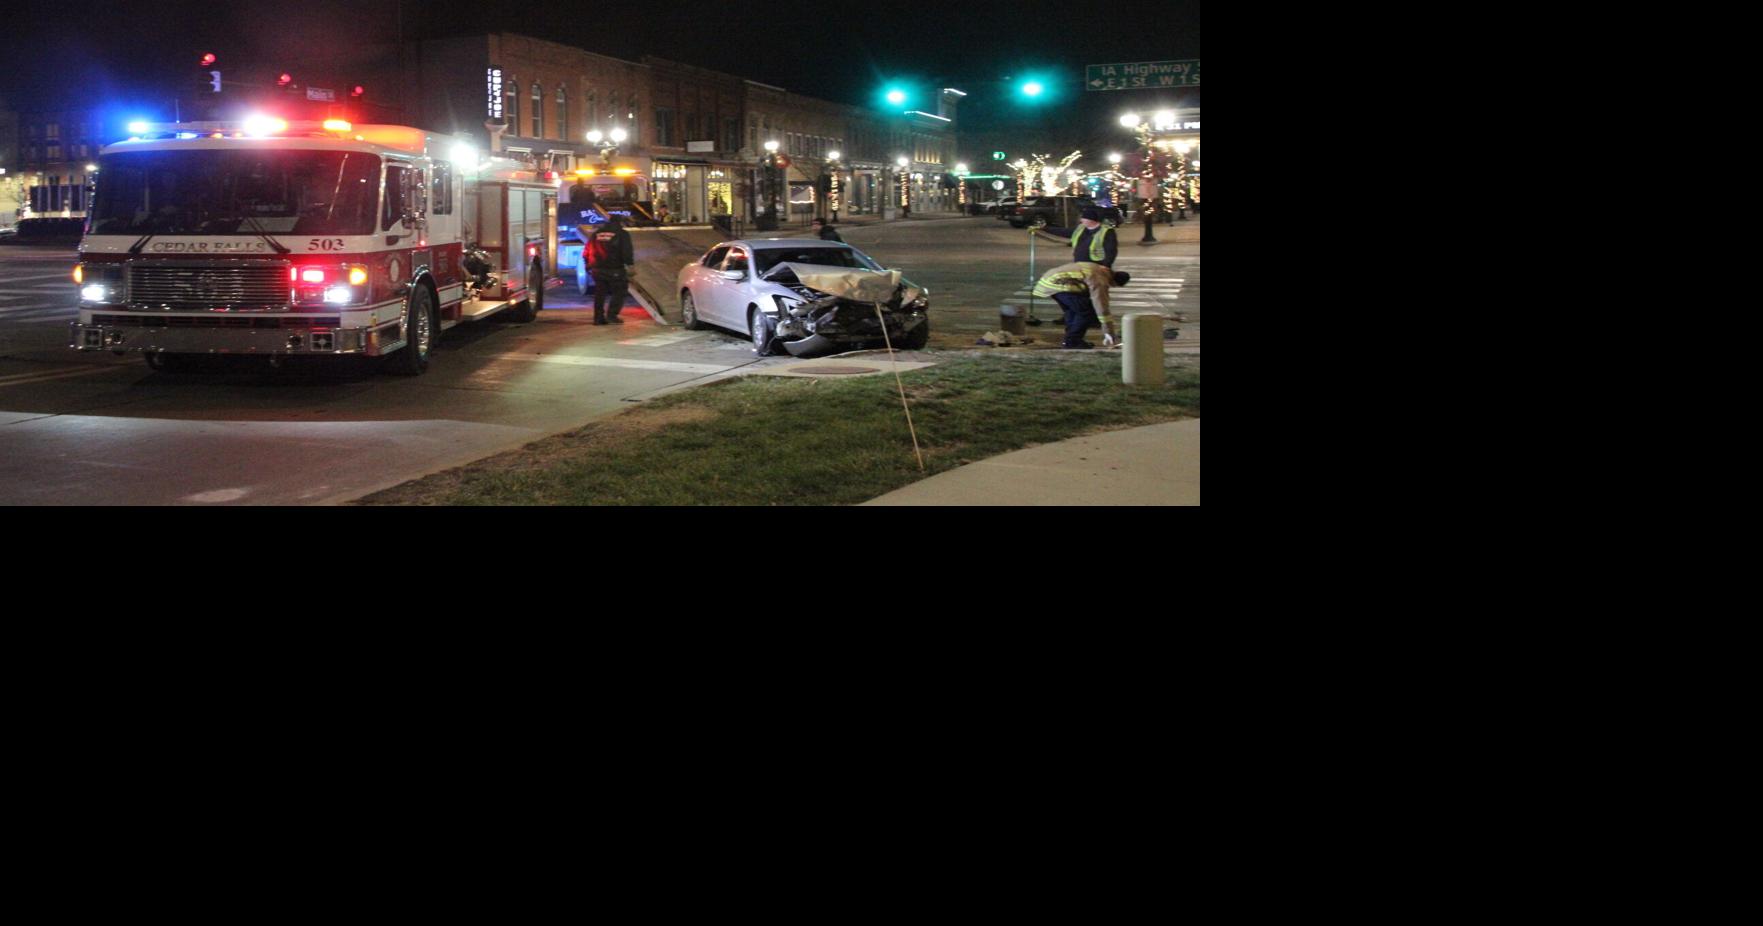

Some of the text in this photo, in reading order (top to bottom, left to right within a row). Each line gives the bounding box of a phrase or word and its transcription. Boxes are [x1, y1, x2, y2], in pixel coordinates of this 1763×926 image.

[1124, 63, 1191, 77] Highway
[1107, 78, 1116, 88] E
[1159, 75, 1175, 86] W
[152, 242, 266, 253] CEDAR FALLS
[308, 238, 345, 251] 503
